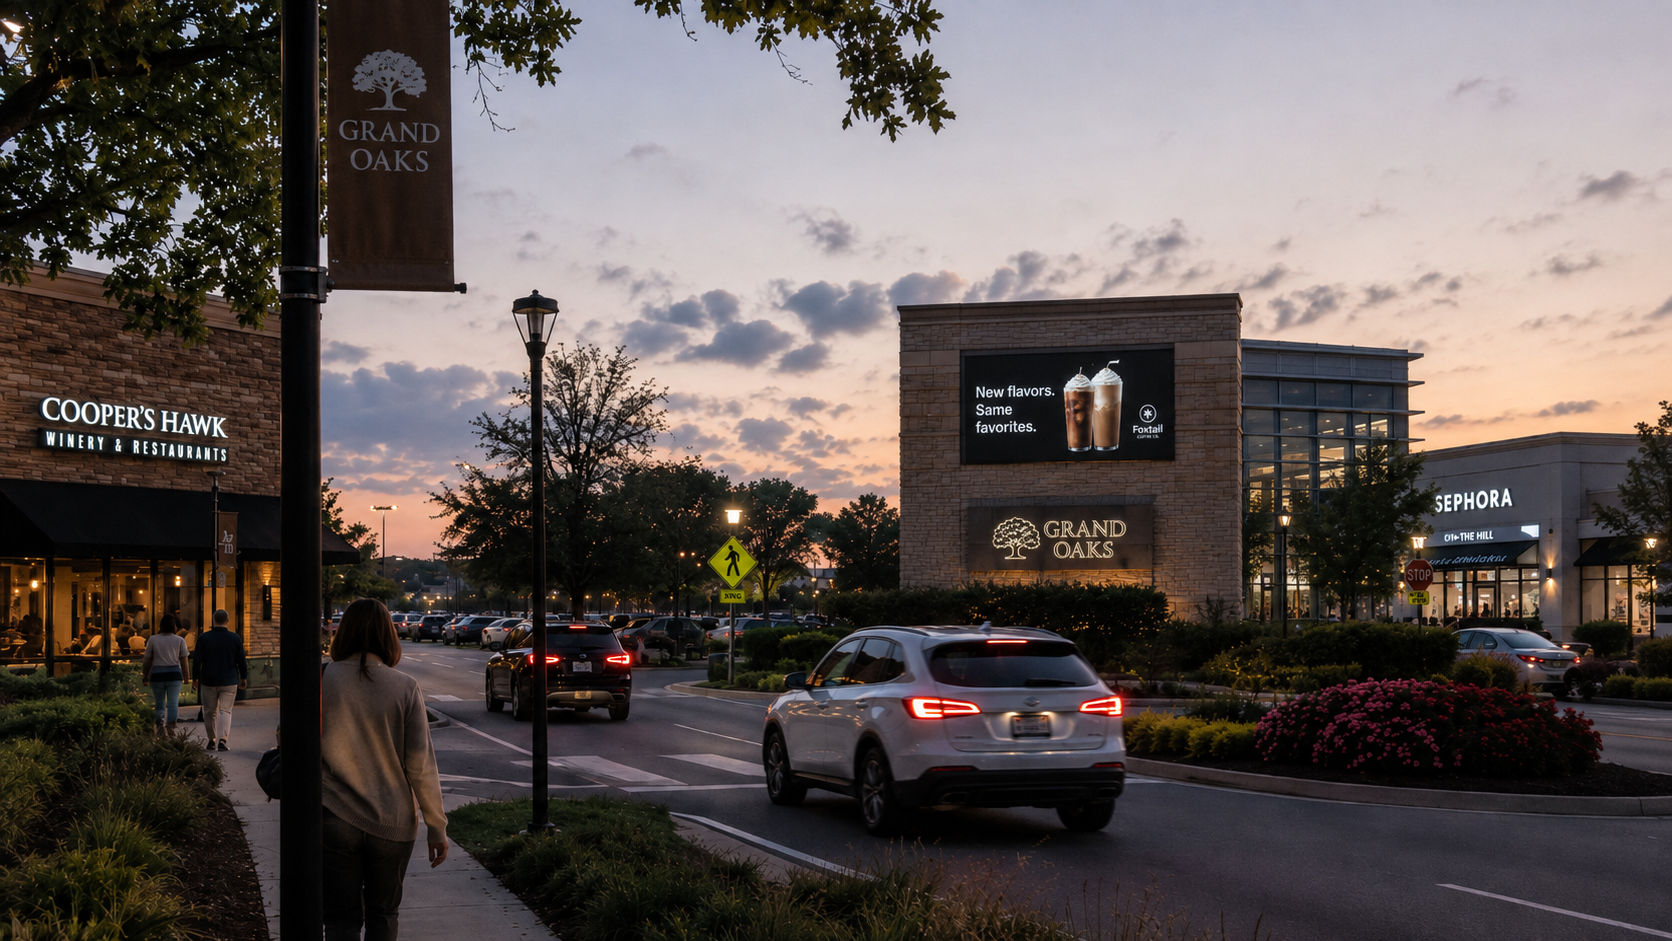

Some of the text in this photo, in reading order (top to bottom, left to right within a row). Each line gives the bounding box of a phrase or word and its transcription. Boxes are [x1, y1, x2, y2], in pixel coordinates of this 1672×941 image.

[339, 120, 440, 143] GRAND
[350, 149, 429, 172] OAKS
[976, 385, 1055, 398] New flavors.
[42, 397, 228, 438] COOPER'S HAWK
[976, 403, 1013, 416] Same
[975, 421, 1037, 434] favorites.
[1132, 424, 1163, 434] Foxtail
[46, 431, 227, 462] WINERY & RESTAURANTS
[1435, 488, 1513, 513] SEPHORA
[1043, 520, 1127, 538] GRAND
[1460, 531, 1475, 542] THE
[1476, 530, 1494, 540] HILL
[1053, 541, 1114, 559] OAKS
[1407, 569, 1431, 581] STOP
